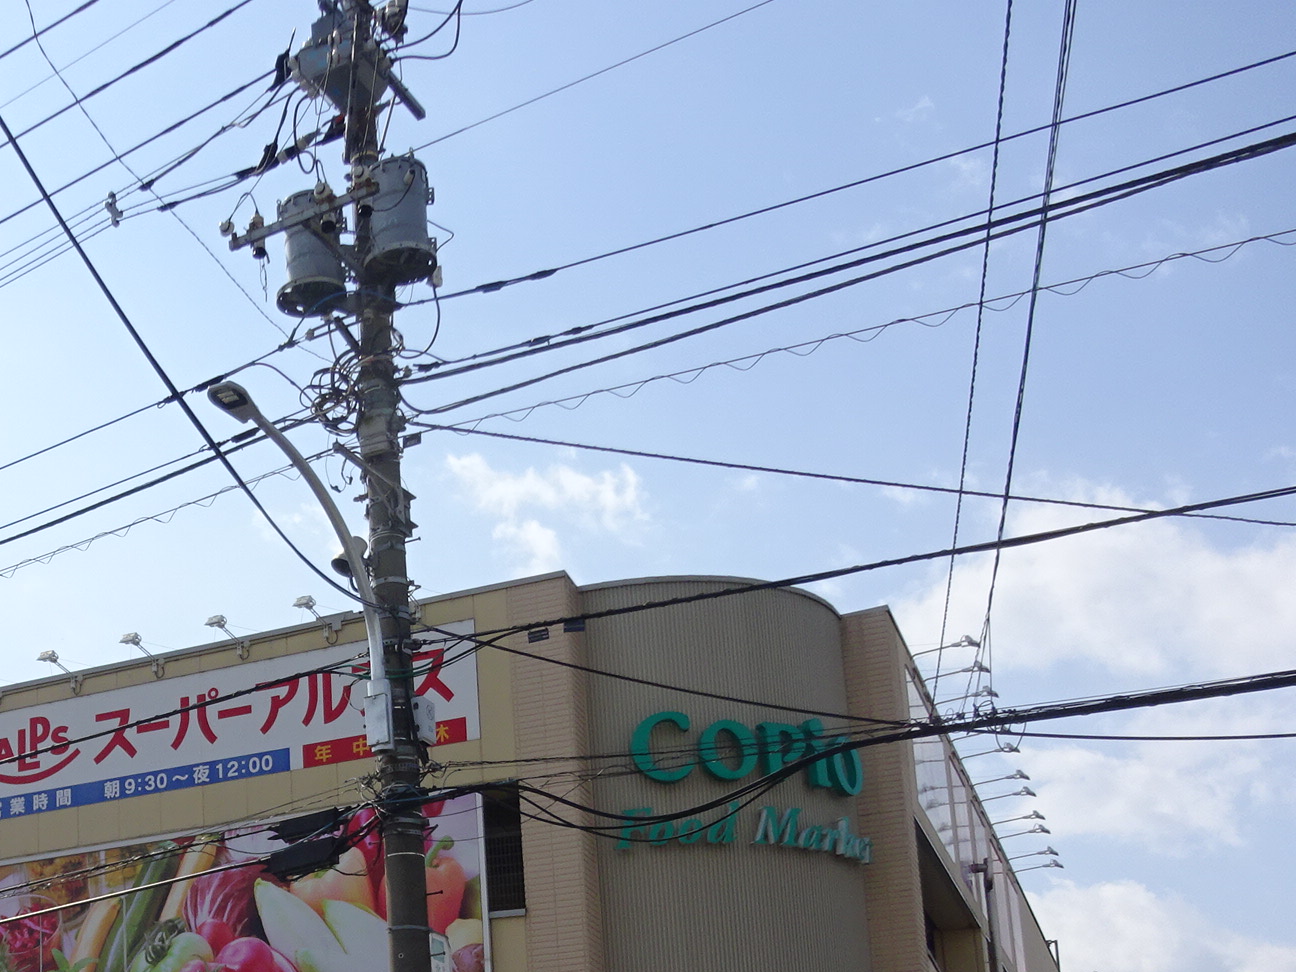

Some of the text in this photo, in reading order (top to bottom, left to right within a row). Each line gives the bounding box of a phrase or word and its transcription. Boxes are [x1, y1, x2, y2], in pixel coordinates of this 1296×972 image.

[93, 648, 455, 765] スーパーアルス
[315, 724, 449, 762] 年中休
[615, 801, 740, 849] Food
